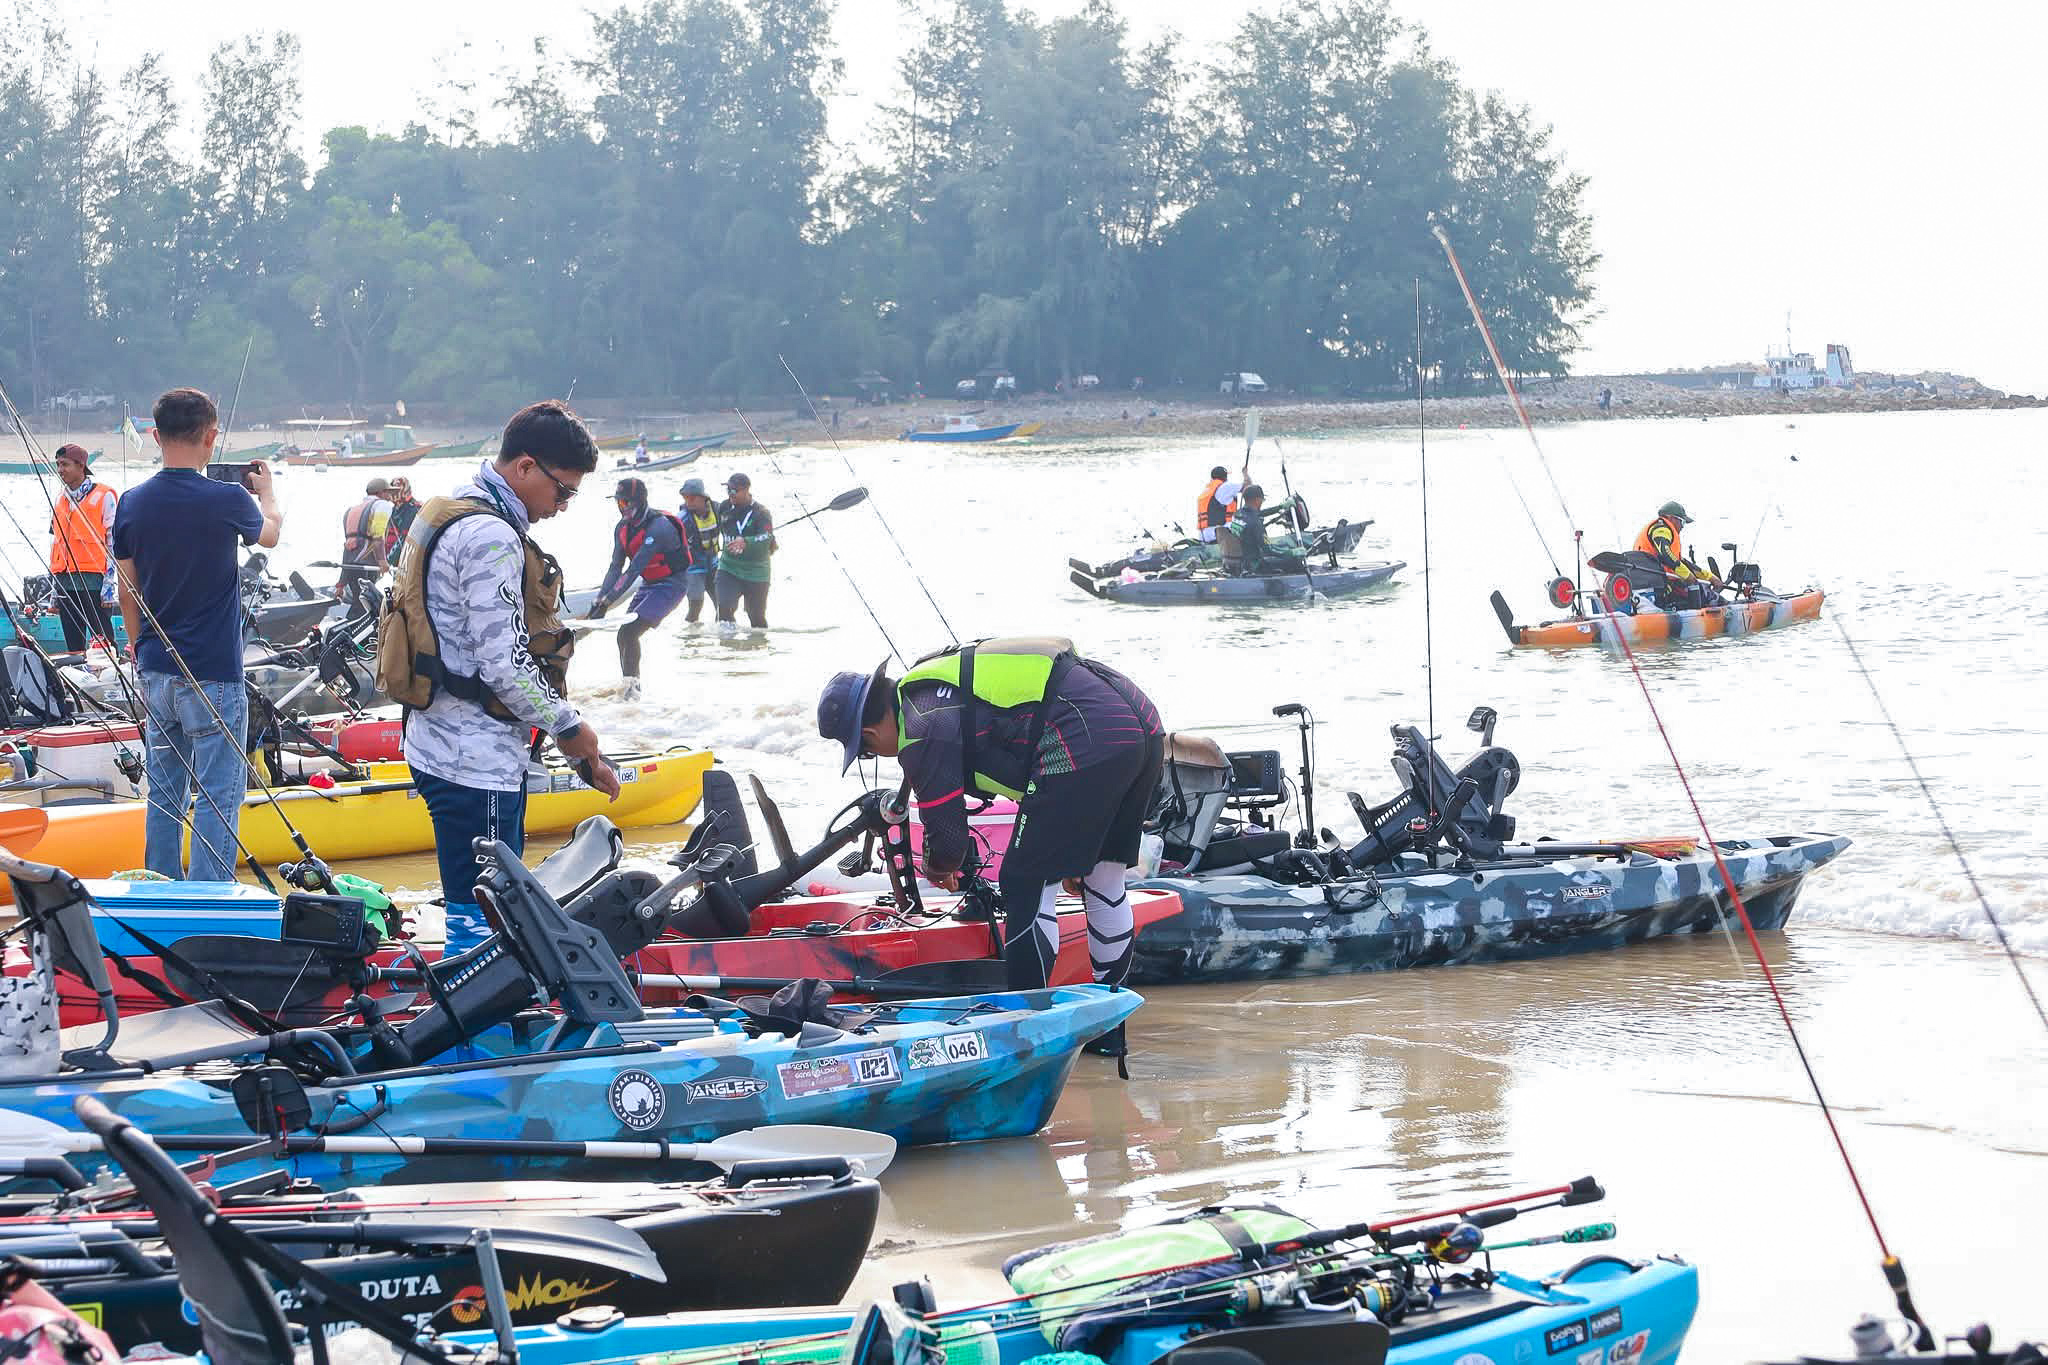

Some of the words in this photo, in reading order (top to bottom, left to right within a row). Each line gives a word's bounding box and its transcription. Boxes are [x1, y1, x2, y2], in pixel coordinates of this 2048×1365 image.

[1567, 887, 1607, 897] ANGLER
[948, 1040, 978, 1059] 046
[860, 1056, 890, 1080] 023
[614, 1074, 630, 1107] KAYAK
[634, 1073, 662, 1108] FISHING
[693, 1080, 757, 1097] ANGLER
[359, 1274, 442, 1301] DUTA
